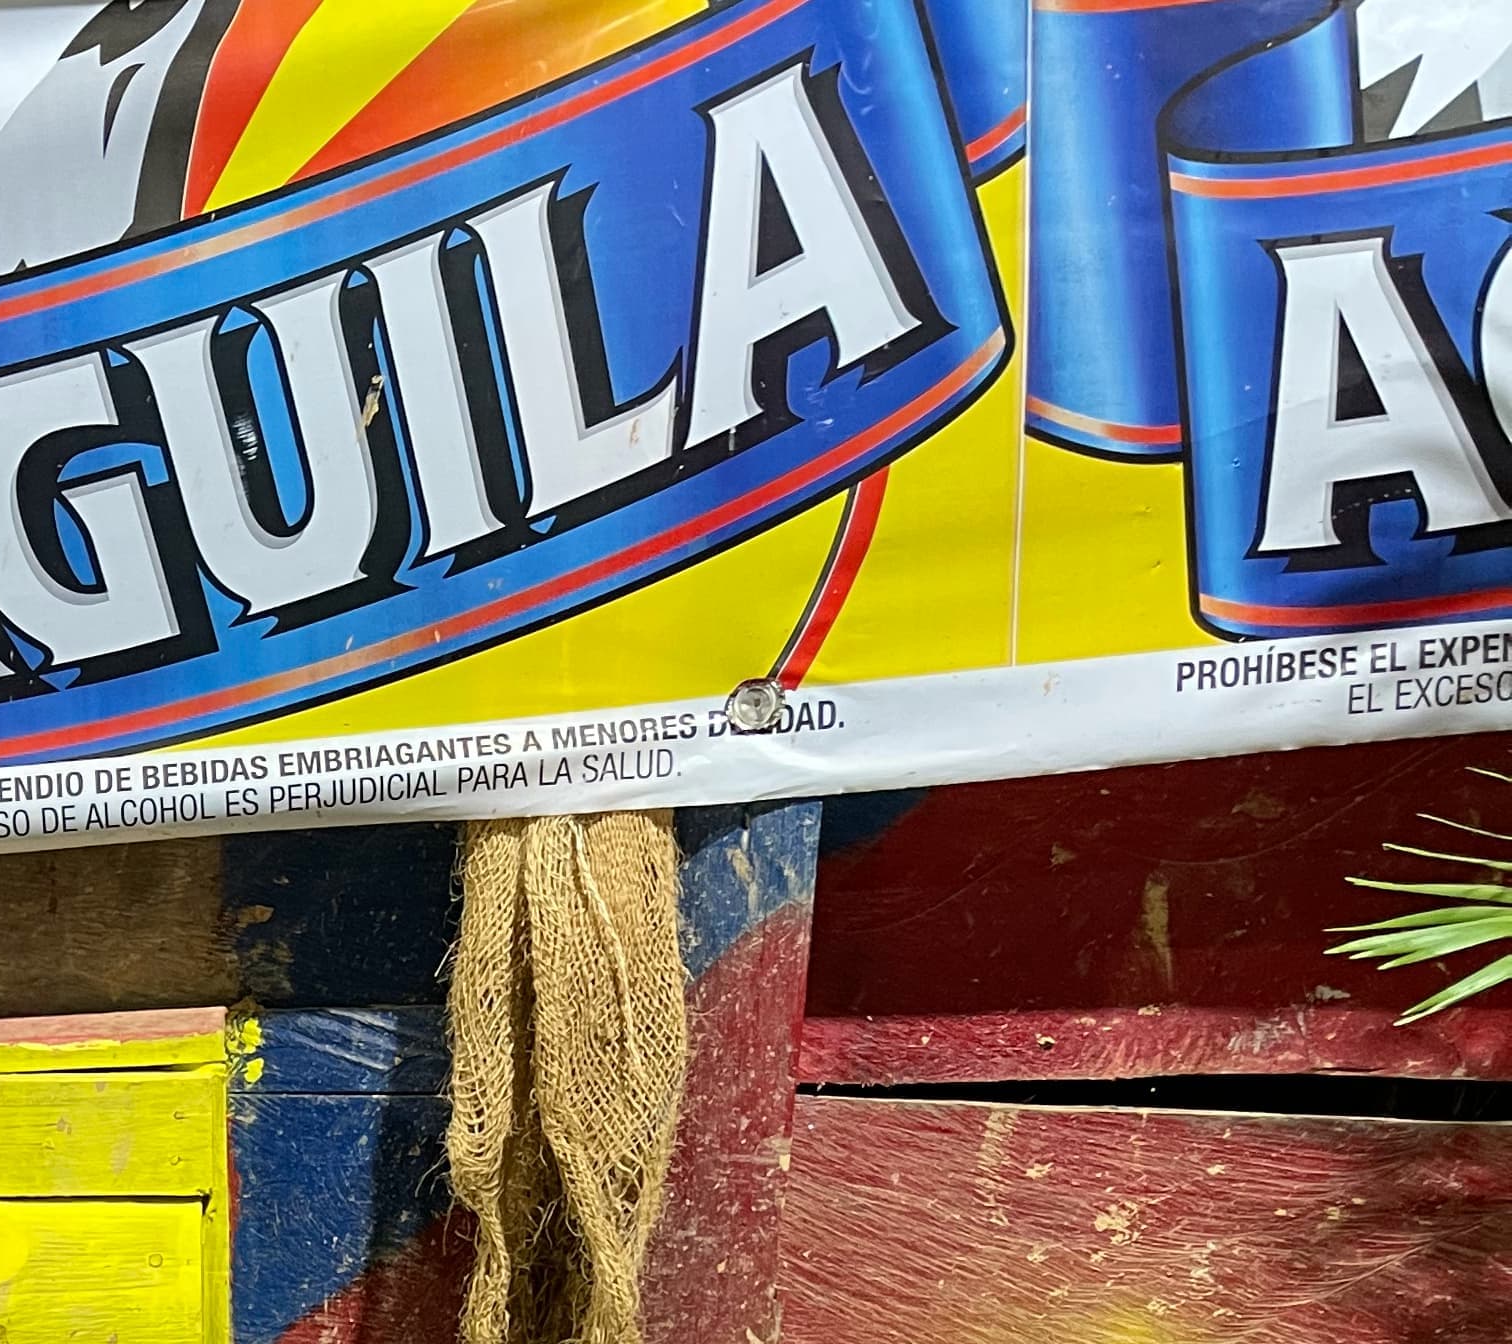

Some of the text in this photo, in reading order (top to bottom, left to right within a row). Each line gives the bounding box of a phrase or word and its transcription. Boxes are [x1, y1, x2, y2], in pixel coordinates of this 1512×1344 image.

[1256, 236, 1512, 553] A
[1176, 645, 1358, 693] PROHÍBESE
[1370, 642, 1407, 674] EL
[1347, 670, 1512, 715] EL EXCESO
[94, 766, 132, 795] DE
[141, 754, 268, 791] BEBIDAS
[279, 732, 512, 778] EMBRIAGANTES
[521, 730, 543, 753] A
[552, 712, 699, 751] MENORES
[708, 710, 748, 738] D
[755, 700, 845, 735] DAD.
[41, 805, 78, 834] DE
[85, 792, 216, 831] ALCOHOL
[225, 788, 259, 817] ES
[269, 769, 448, 814] PERJUDICIAL
[457, 759, 529, 793] PARA
[539, 757, 573, 786] LA
[582, 748, 683, 783] SALUD.
